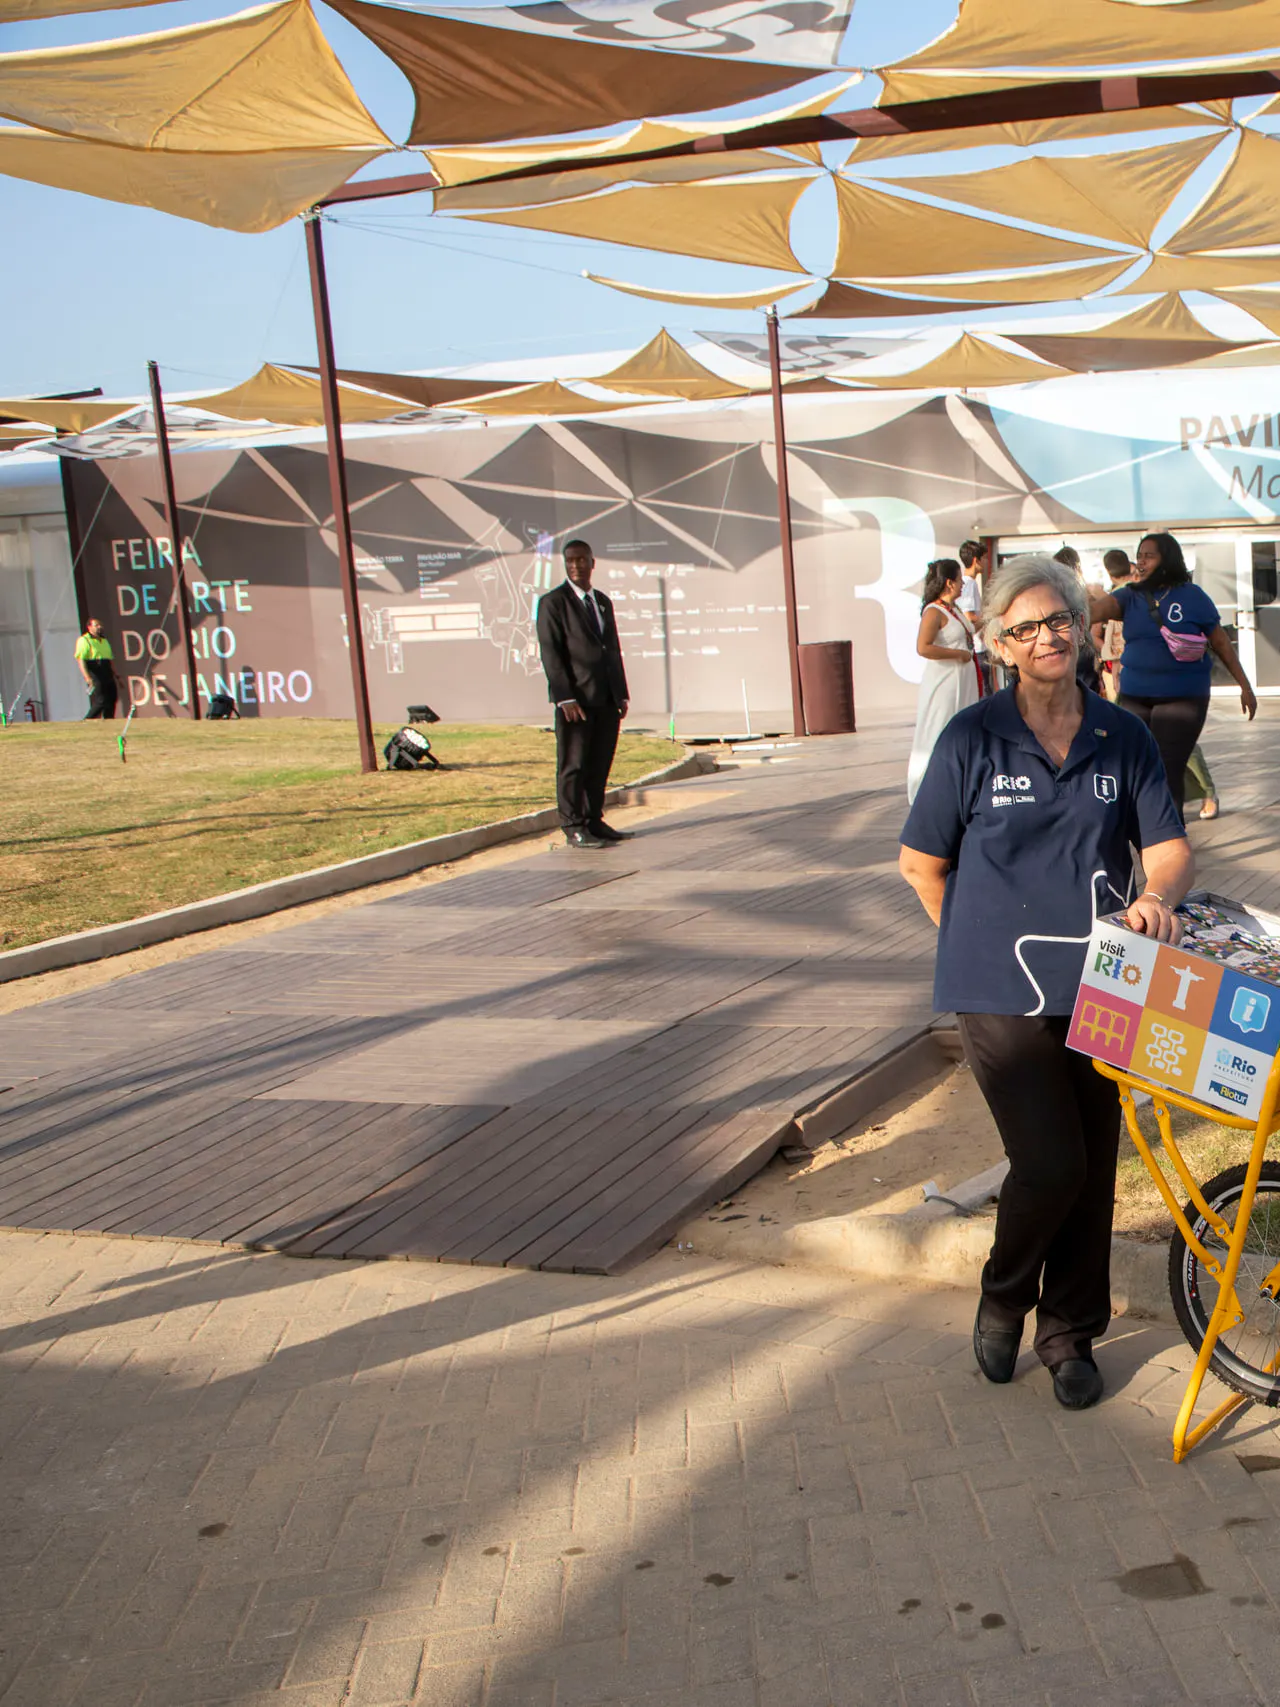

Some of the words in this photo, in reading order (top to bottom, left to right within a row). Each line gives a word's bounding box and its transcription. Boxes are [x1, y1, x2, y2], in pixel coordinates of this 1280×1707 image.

[112, 536, 203, 571] FEIRA
[116, 584, 160, 616] DE
[122, 628, 171, 661] DO
[128, 674, 169, 706] DE
[178, 669, 313, 706] JANEIRO
[1099, 940, 1126, 959] visit
[1093, 951, 1143, 987] RIO
[1232, 1055, 1257, 1076] Rio
[1219, 1085, 1248, 1104] Riotur
